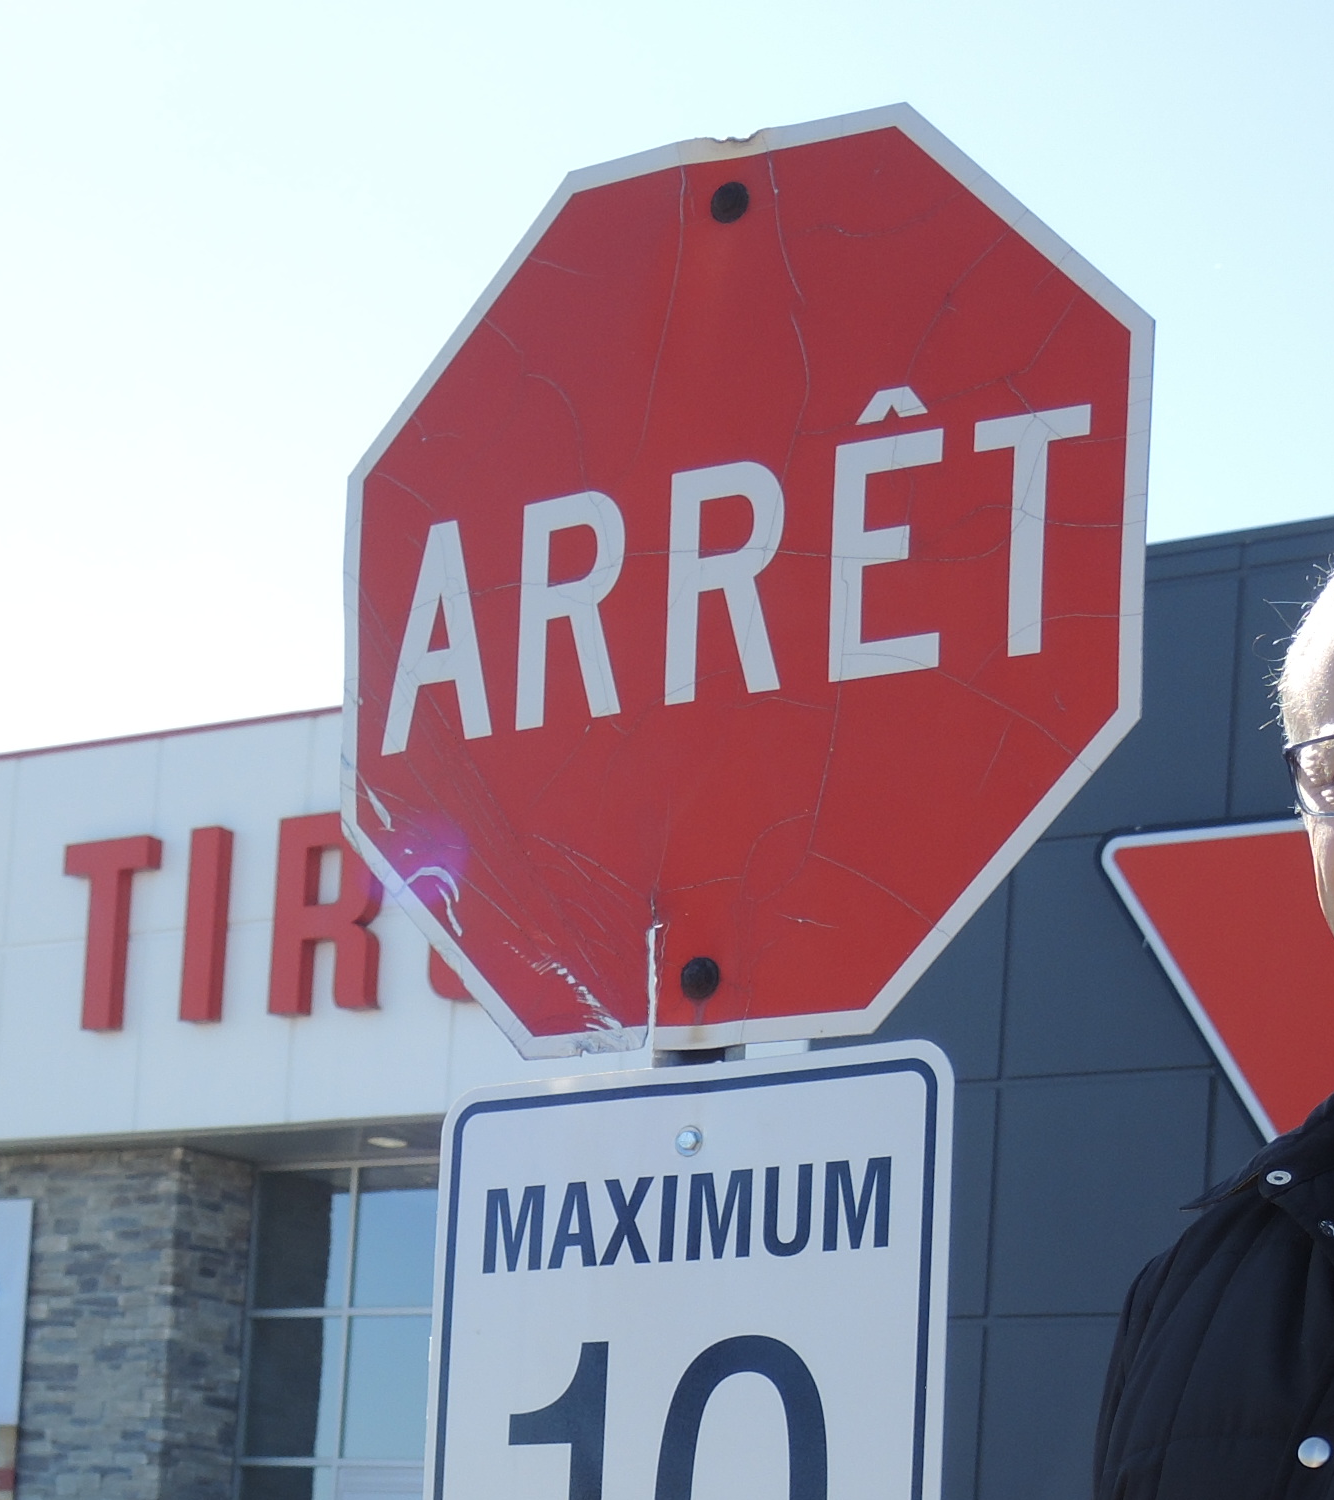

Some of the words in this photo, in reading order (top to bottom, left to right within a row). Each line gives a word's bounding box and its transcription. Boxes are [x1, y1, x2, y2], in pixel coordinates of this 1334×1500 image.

[380, 385, 1092, 757] ARRÊT
[63, 811, 481, 1032] TIR
[481, 1155, 893, 1275] MAXIMUM
